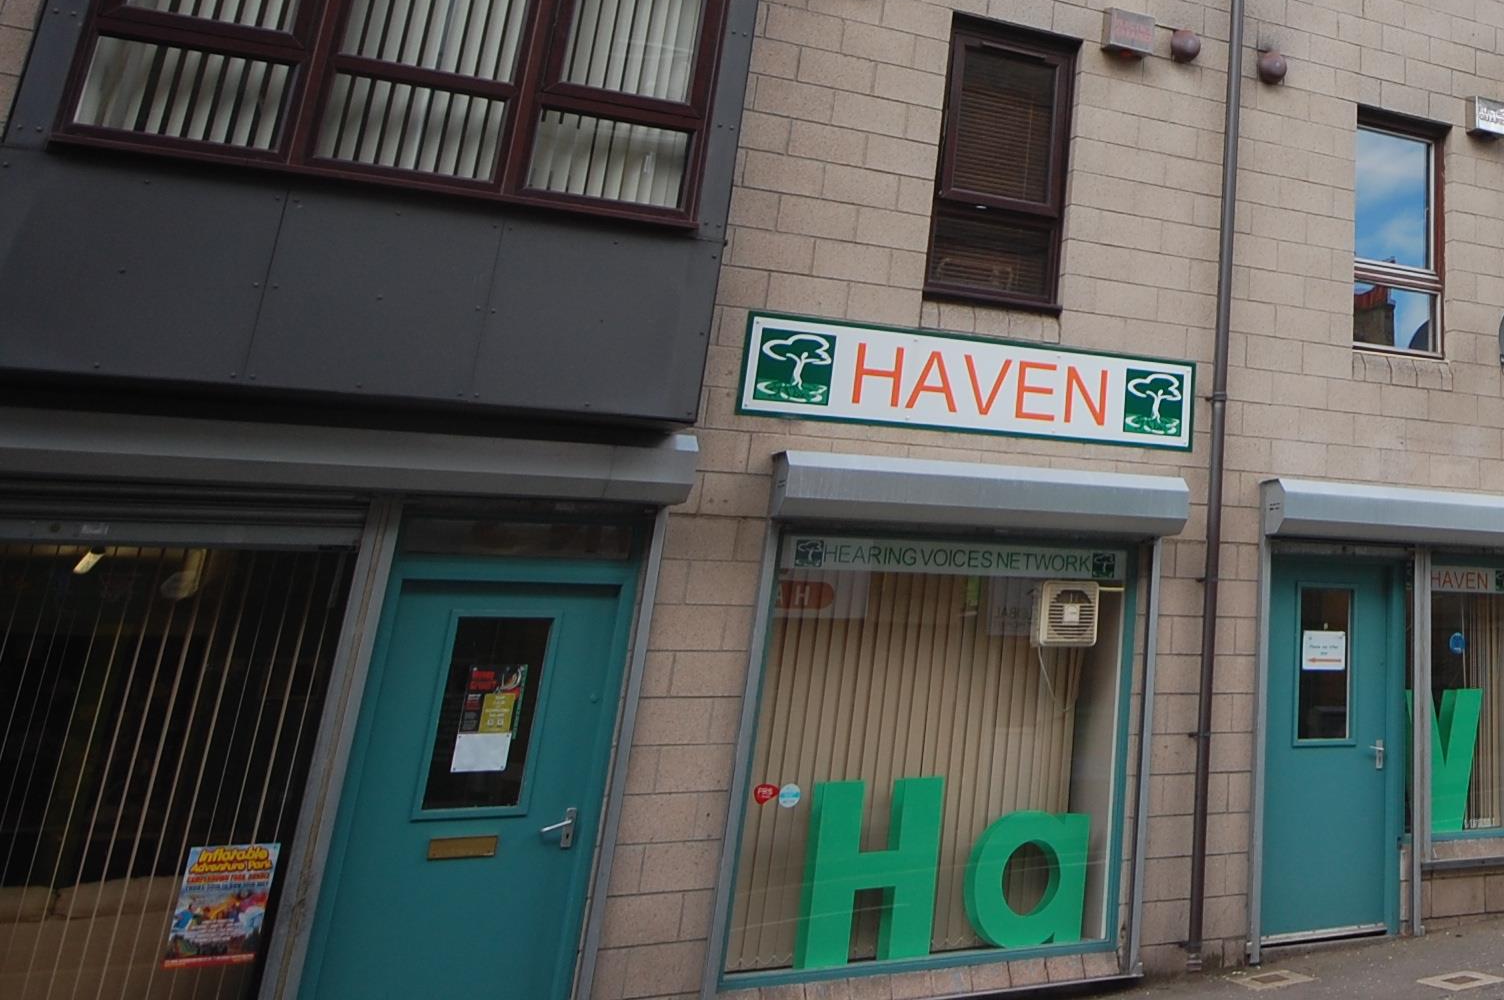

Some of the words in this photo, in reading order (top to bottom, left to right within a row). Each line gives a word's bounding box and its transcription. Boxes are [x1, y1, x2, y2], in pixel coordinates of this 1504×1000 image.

[852, 342, 1108, 426] HAVEN
[823, 545, 917, 567] HEARING
[920, 549, 993, 569] VOICES
[996, 552, 1092, 573] NETWORK
[1431, 570, 1488, 591] HAVEN
[199, 846, 269, 863] Inflatable
[190, 862, 246, 874] Adventure
[247, 859, 273, 871] Park
